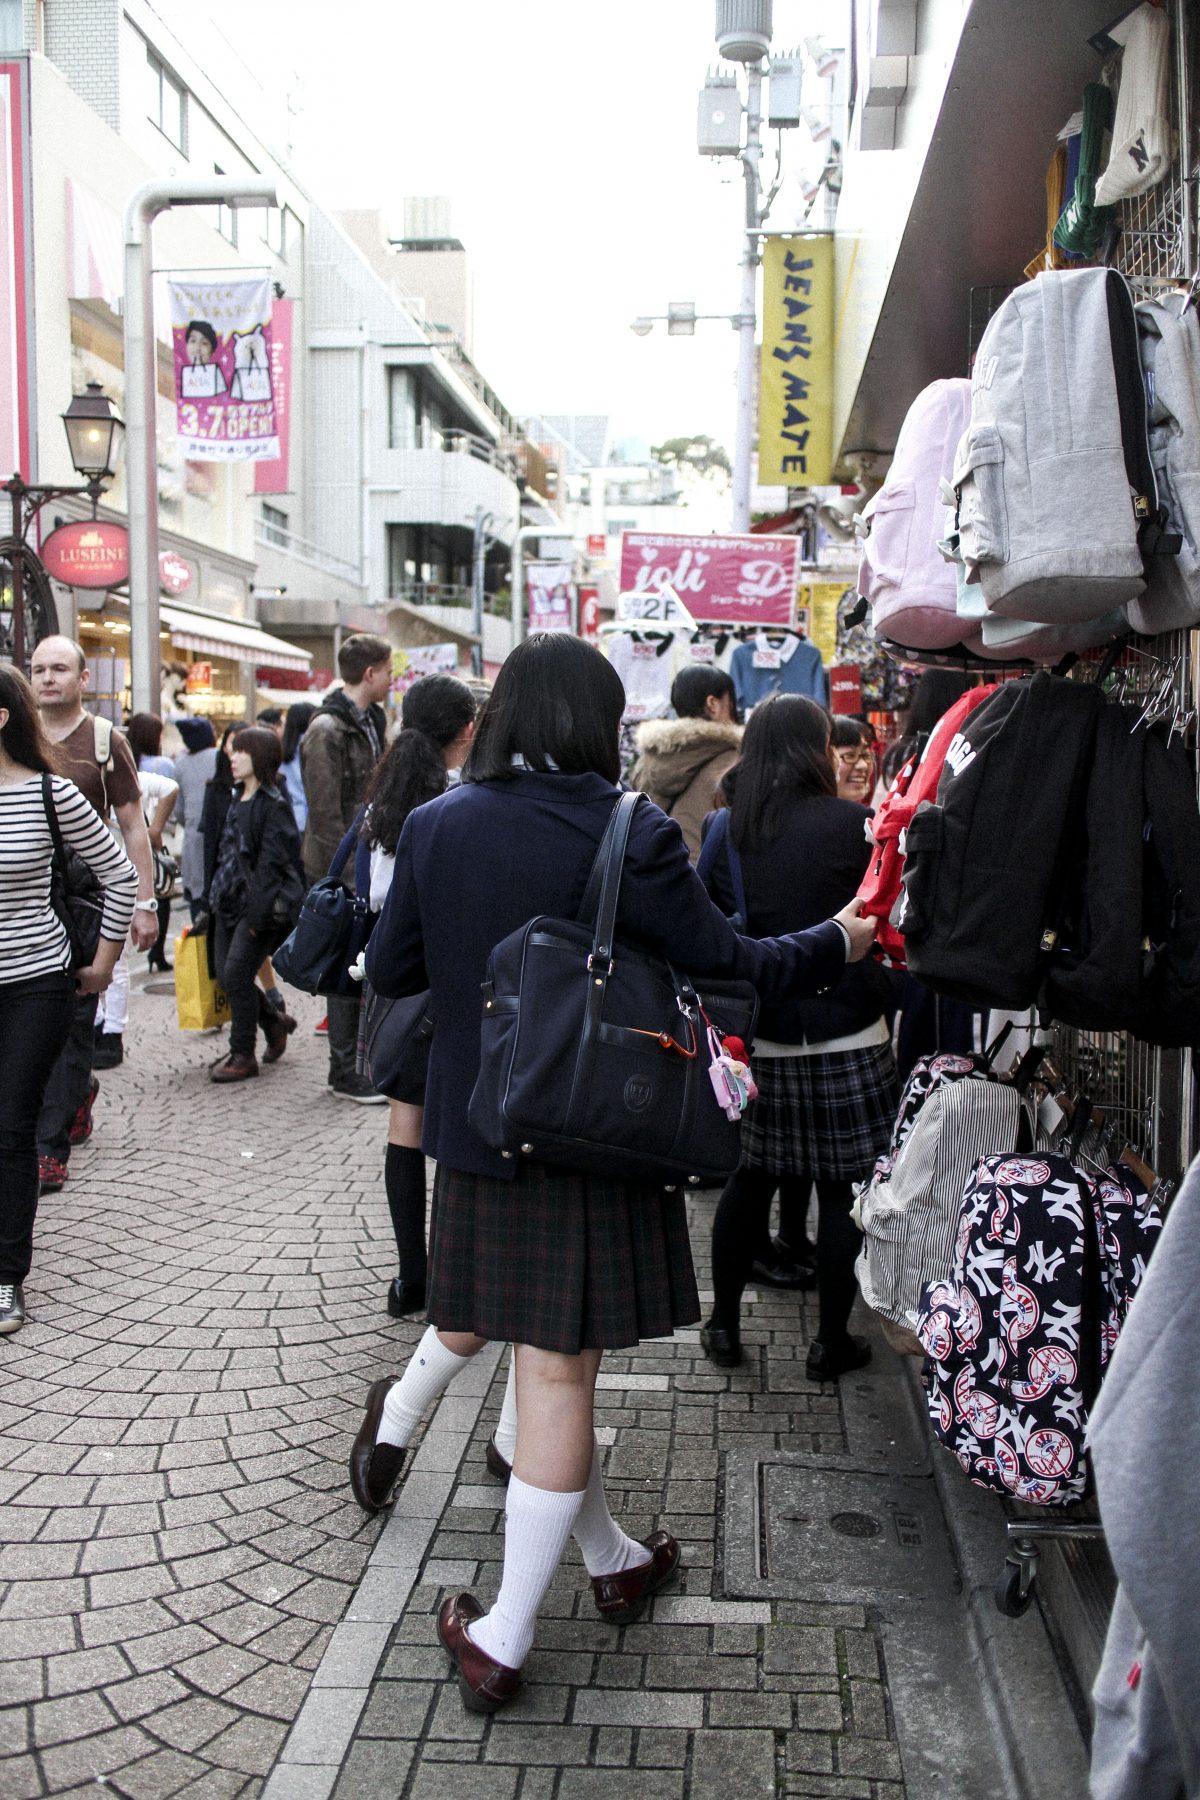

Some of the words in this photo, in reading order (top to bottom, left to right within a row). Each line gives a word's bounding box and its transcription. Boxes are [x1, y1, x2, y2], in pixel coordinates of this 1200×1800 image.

[771, 249, 814, 363] JEANS
[780, 370, 813, 475] MATE
[60, 547, 128, 562] LUSEINE
